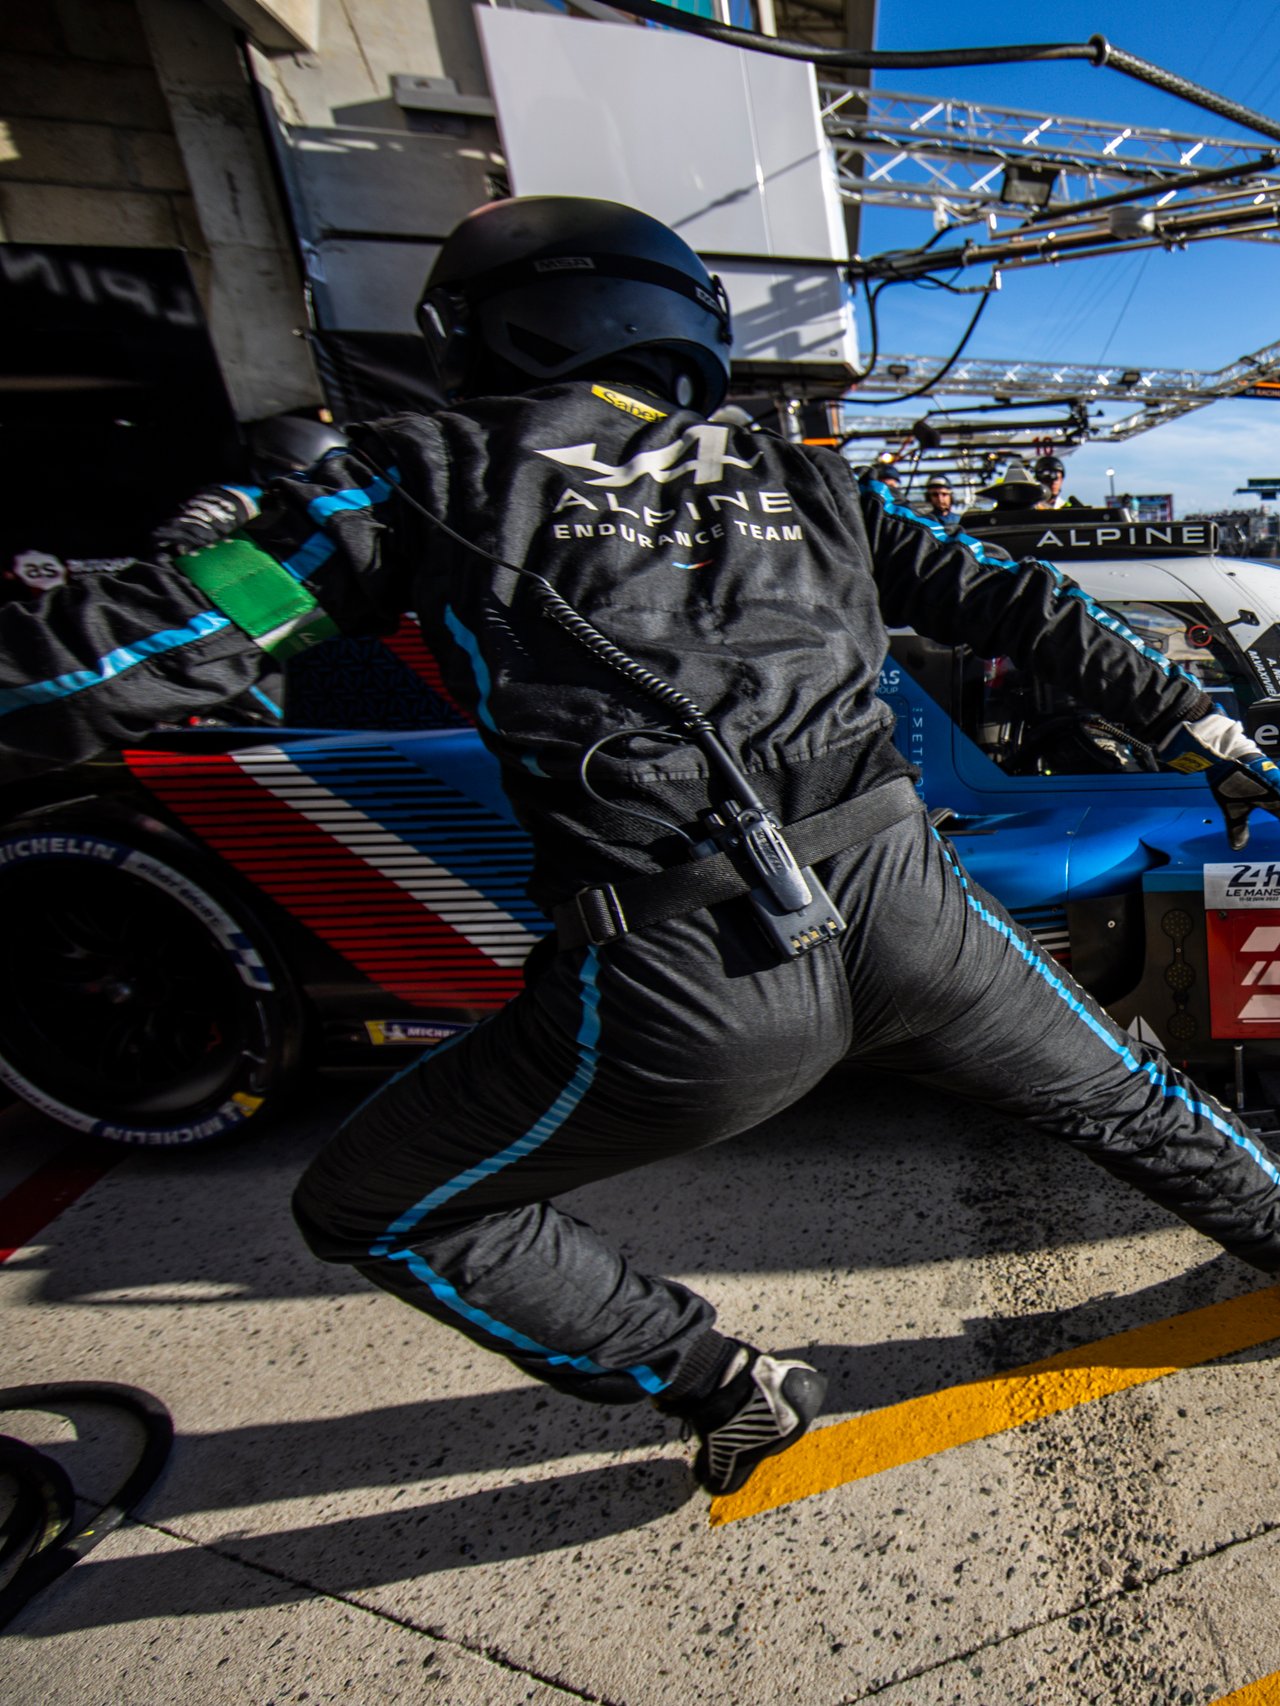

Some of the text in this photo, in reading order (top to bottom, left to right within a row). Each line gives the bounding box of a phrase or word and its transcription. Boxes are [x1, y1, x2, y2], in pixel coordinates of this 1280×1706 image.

[552, 488, 793, 527] ALPINE
[553, 520, 803, 549] ENDURANCE TEAM
[1036, 526, 1205, 548] ALPINE
[1225, 889, 1243, 897] LE
[103, 1115, 225, 1145] MICHELIN
